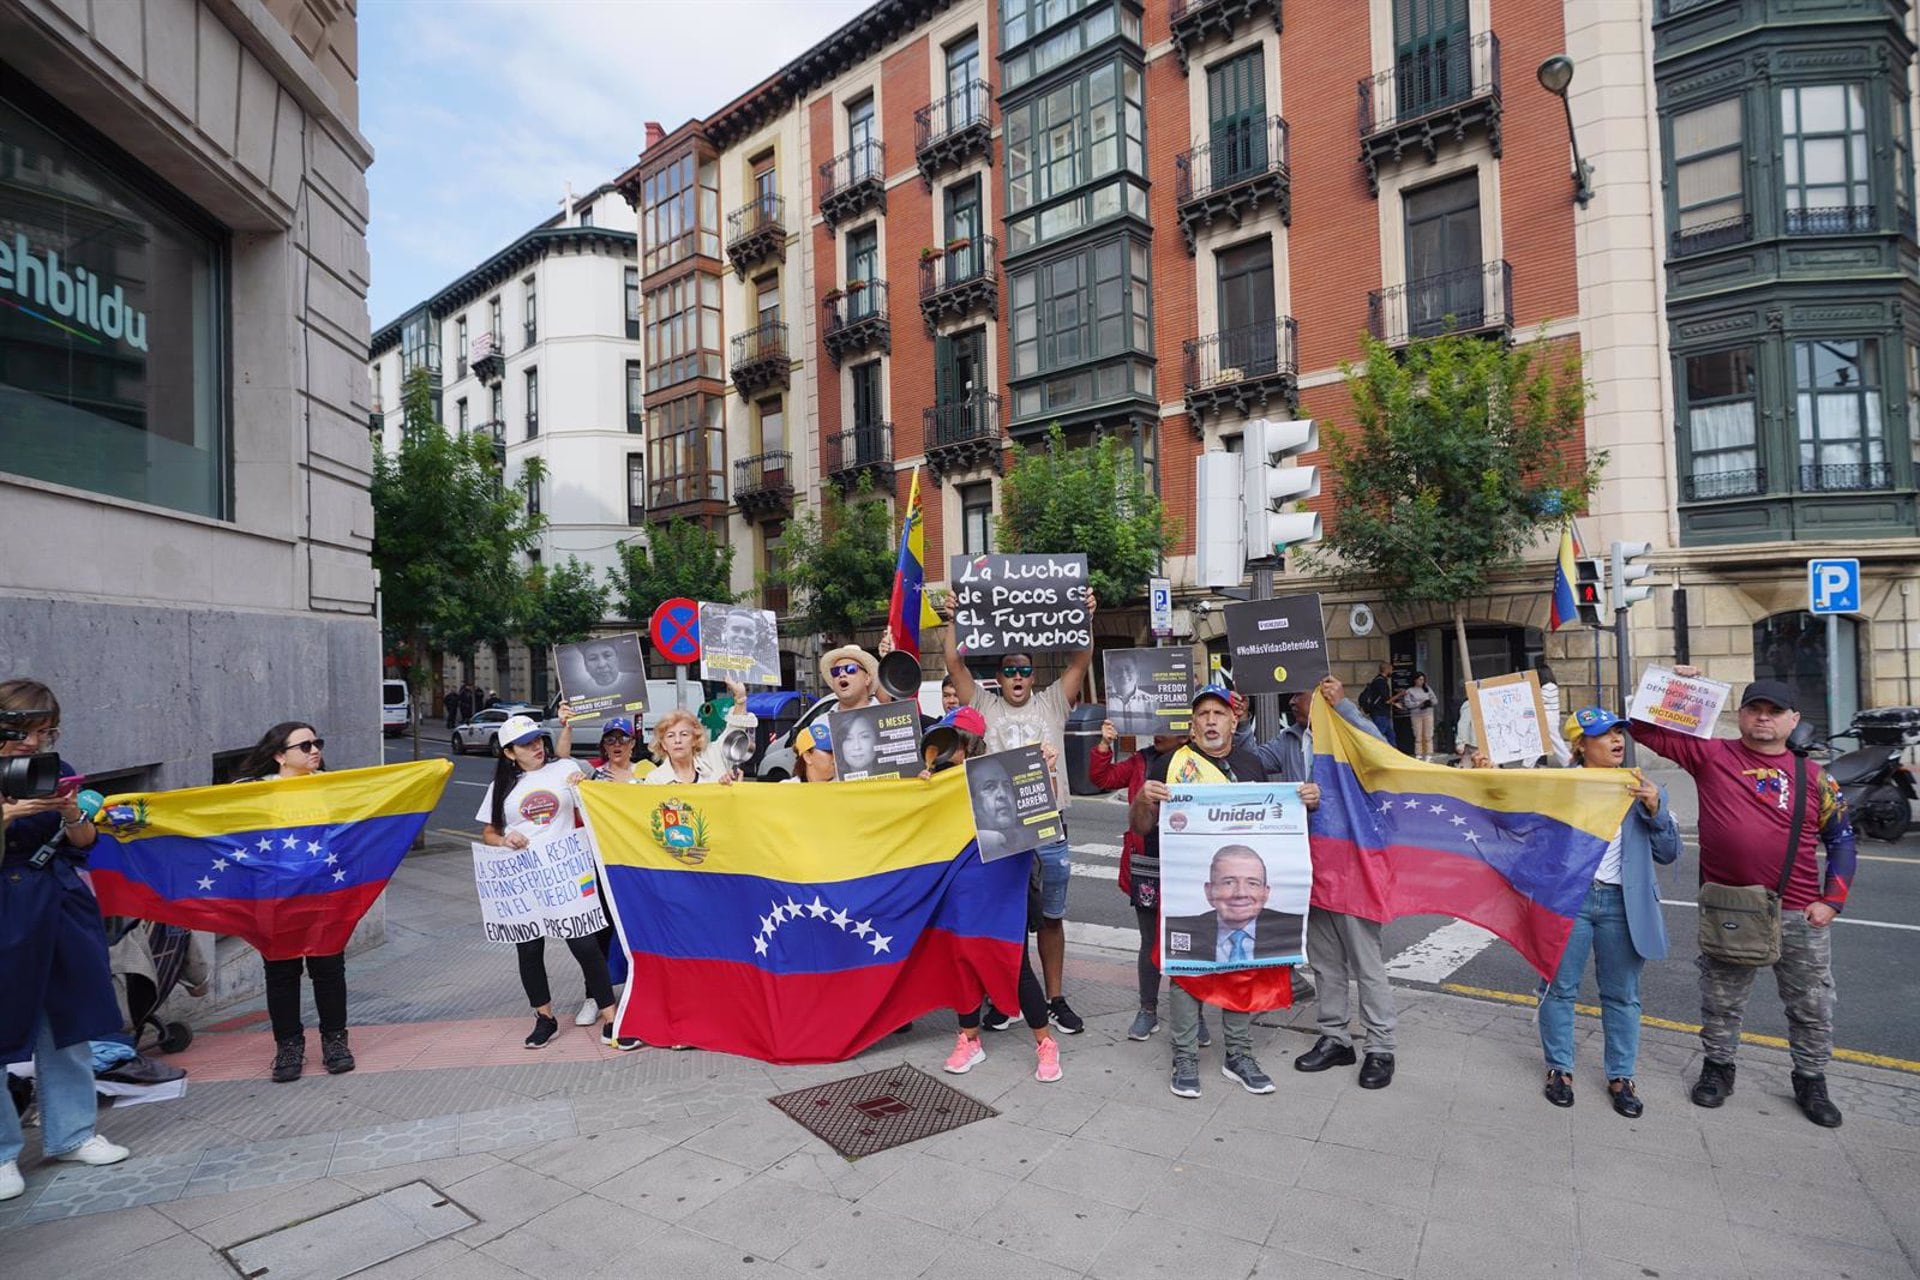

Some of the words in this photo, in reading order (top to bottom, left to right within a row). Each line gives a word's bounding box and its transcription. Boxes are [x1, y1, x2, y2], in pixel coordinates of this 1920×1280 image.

[0, 233, 148, 352] ehbildu
[960, 561, 992, 583] La
[1004, 560, 1081, 580] Lucha
[959, 586, 982, 605] de
[1821, 566, 1850, 607] P
[965, 628, 995, 650] de
[1002, 628, 1090, 648] muchos
[1237, 639, 1319, 656] #NoMásVidasDetenidas
[1144, 693, 1188, 703] SUPERLANO
[1158, 684, 1188, 693] FREDDY
[878, 719, 885, 729] 6
[885, 714, 913, 728] MESES
[1019, 782, 1046, 798] ROLAND
[1016, 792, 1049, 810] CARREÑO
[1207, 808, 1267, 822] Unidad
[545, 833, 582, 863] RESIDE
[495, 900, 513, 919] EN
[514, 898, 532, 914] EL
[533, 880, 578, 907] PUEBLO
[486, 920, 541, 943] EDMUNDO
[543, 907, 609, 939] PRESIDENTE
